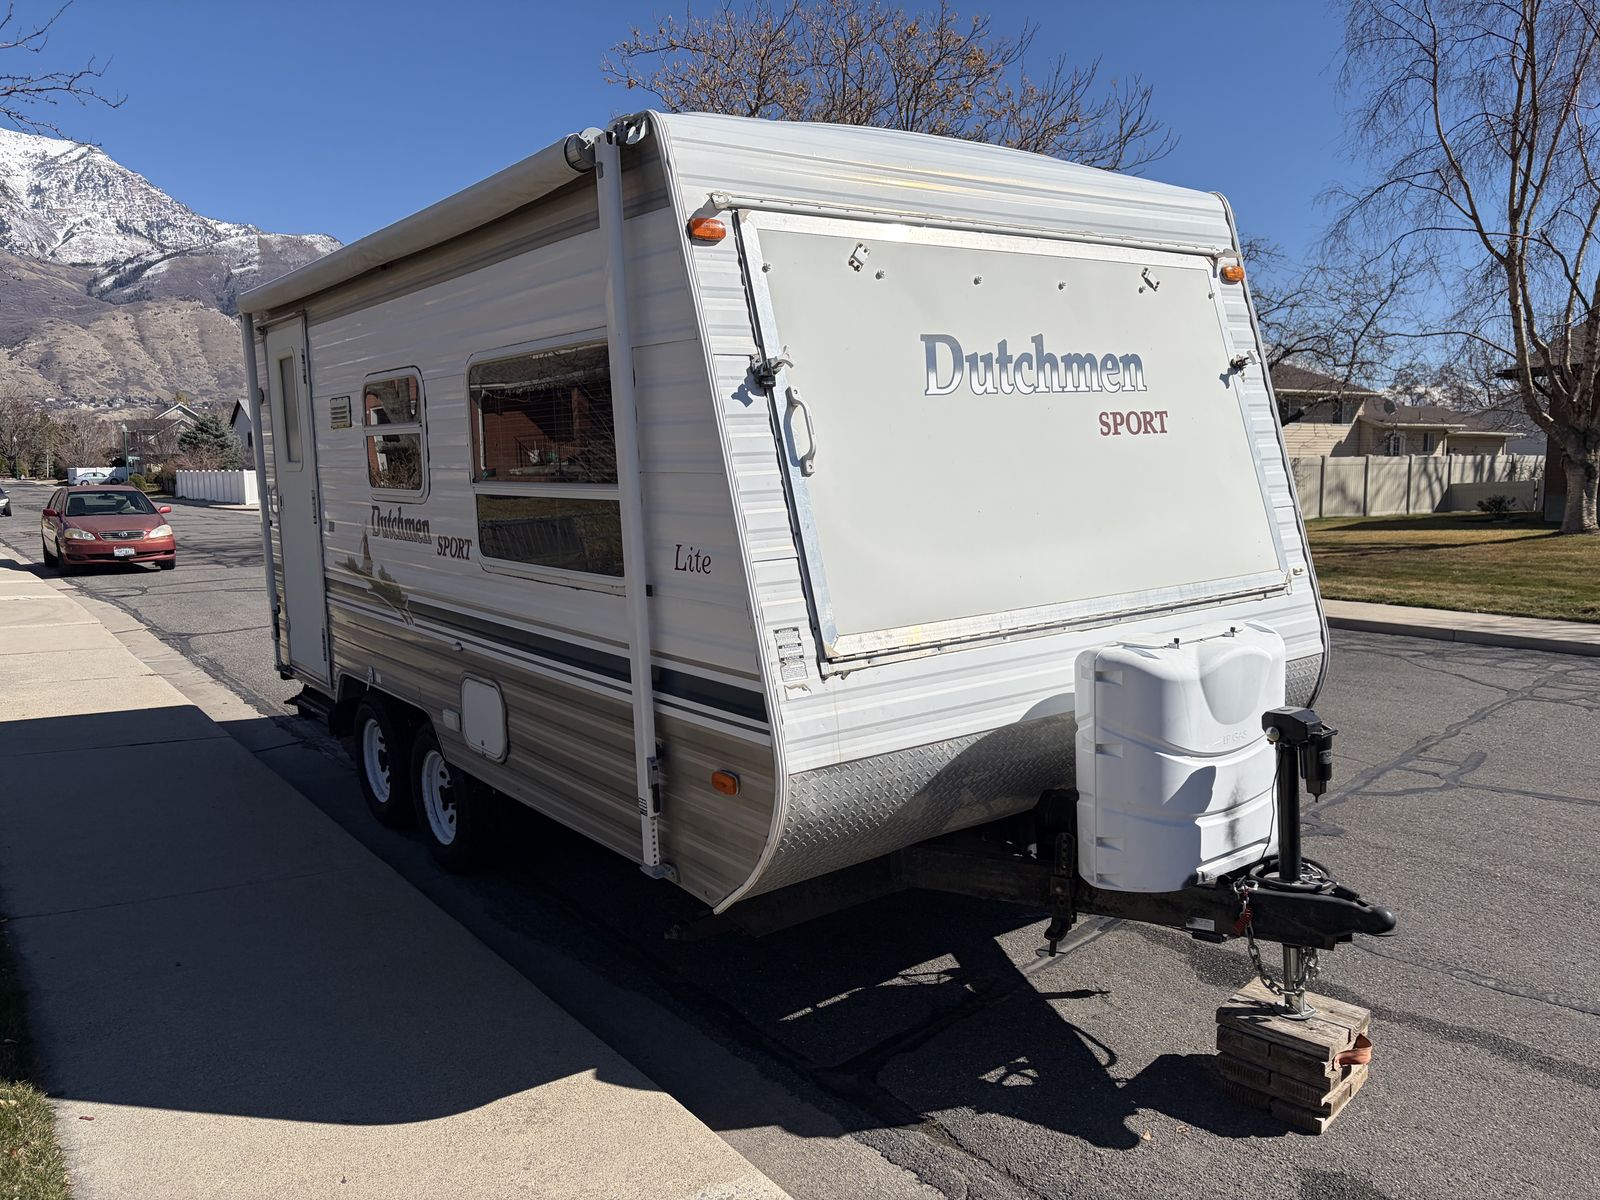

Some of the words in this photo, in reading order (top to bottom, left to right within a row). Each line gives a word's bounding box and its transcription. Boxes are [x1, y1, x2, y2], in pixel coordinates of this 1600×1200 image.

[919, 333, 1148, 396] Dutchmen
[1098, 410, 1169, 436] SPORT
[371, 505, 432, 544] Dutchmen
[437, 535, 473, 560] SPORT
[674, 544, 712, 574] Lite
